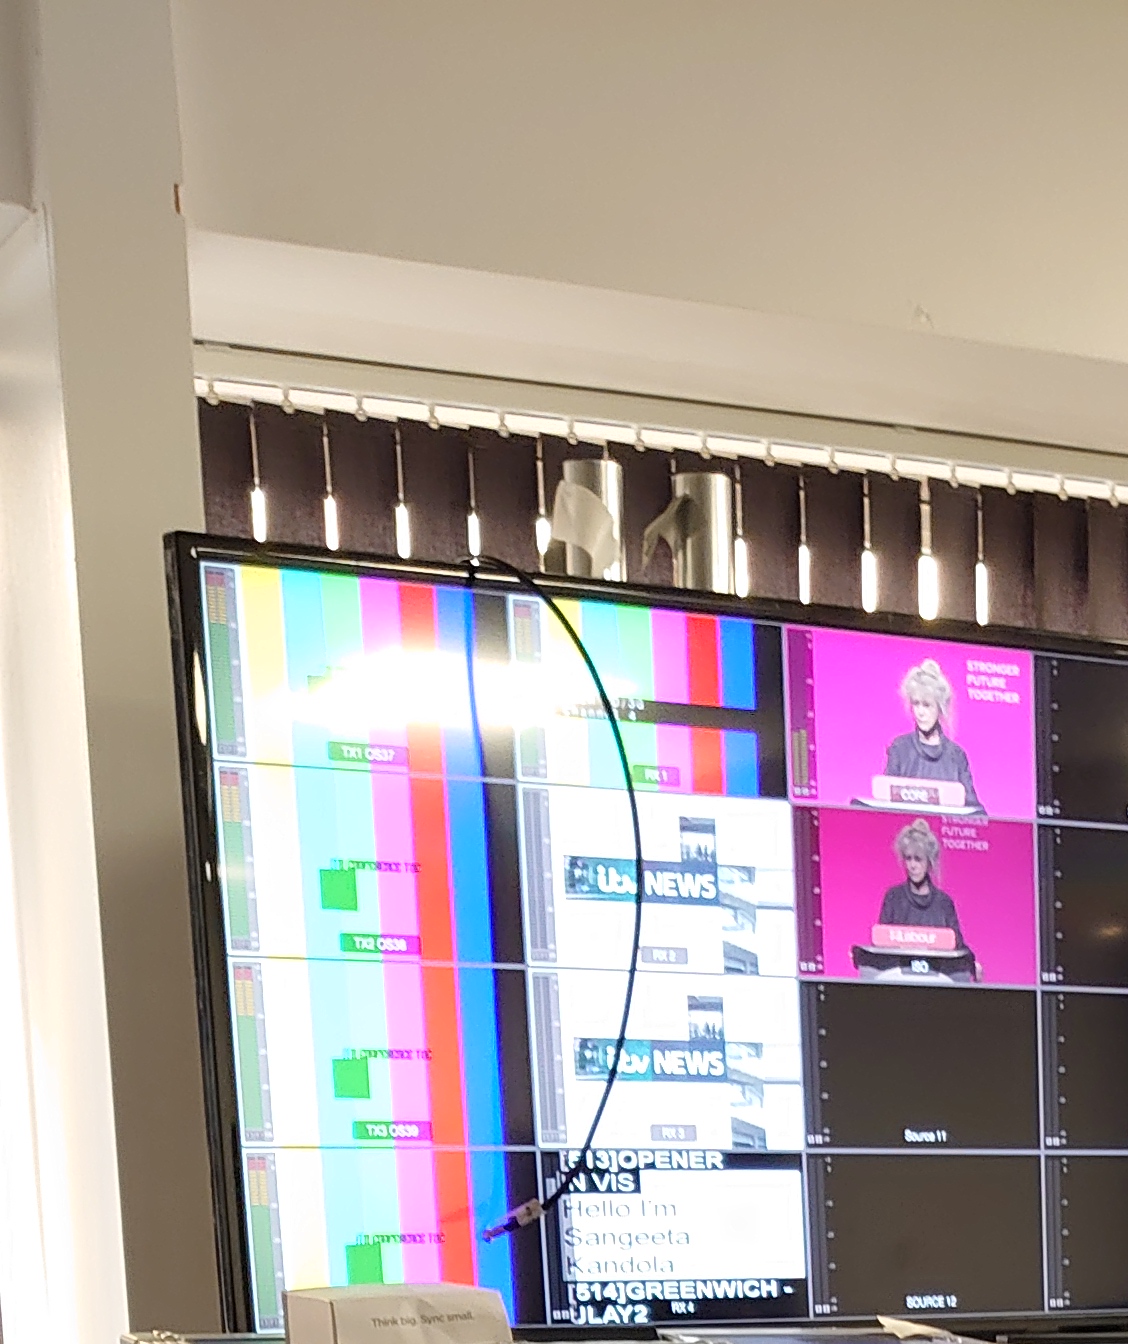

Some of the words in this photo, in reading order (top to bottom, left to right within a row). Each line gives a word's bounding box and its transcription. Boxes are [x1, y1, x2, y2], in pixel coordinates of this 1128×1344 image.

[966, 660, 1020, 677] STRONGER
[966, 674, 1007, 689] FUTURE
[967, 689, 1020, 705] TOGETHER
[596, 865, 638, 894] itv
[644, 870, 718, 899] NEWS
[606, 1042, 649, 1075] itv
[653, 1049, 725, 1077] NEWS
[594, 1172, 635, 1192] VIS
[563, 1199, 630, 1218] Hello
[563, 1226, 691, 1250] Sangeeta
[566, 1256, 675, 1275] Kandola
[568, 1279, 778, 1304] [514]GREENWICH
[371, 1315, 399, 1329] Think
[420, 1313, 443, 1328] Sync
[445, 1310, 475, 1323] small.
